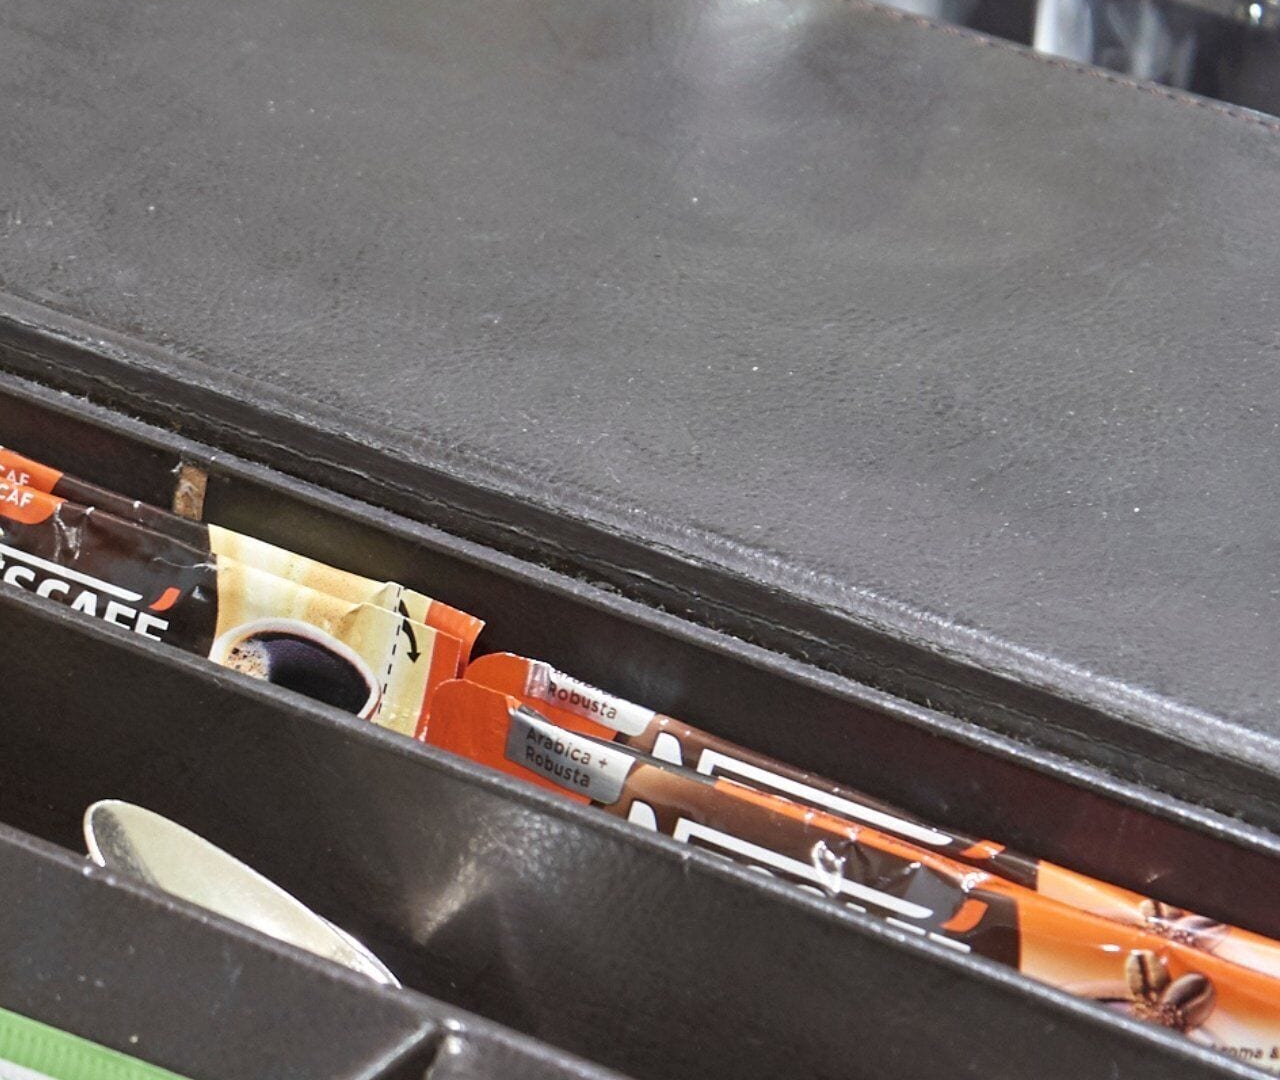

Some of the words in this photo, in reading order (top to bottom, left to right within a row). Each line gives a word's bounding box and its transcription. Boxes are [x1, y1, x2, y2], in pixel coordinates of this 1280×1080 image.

[546, 681, 618, 719] Robusta
[525, 727, 592, 766] Arabica
[524, 745, 591, 788] Robusta
